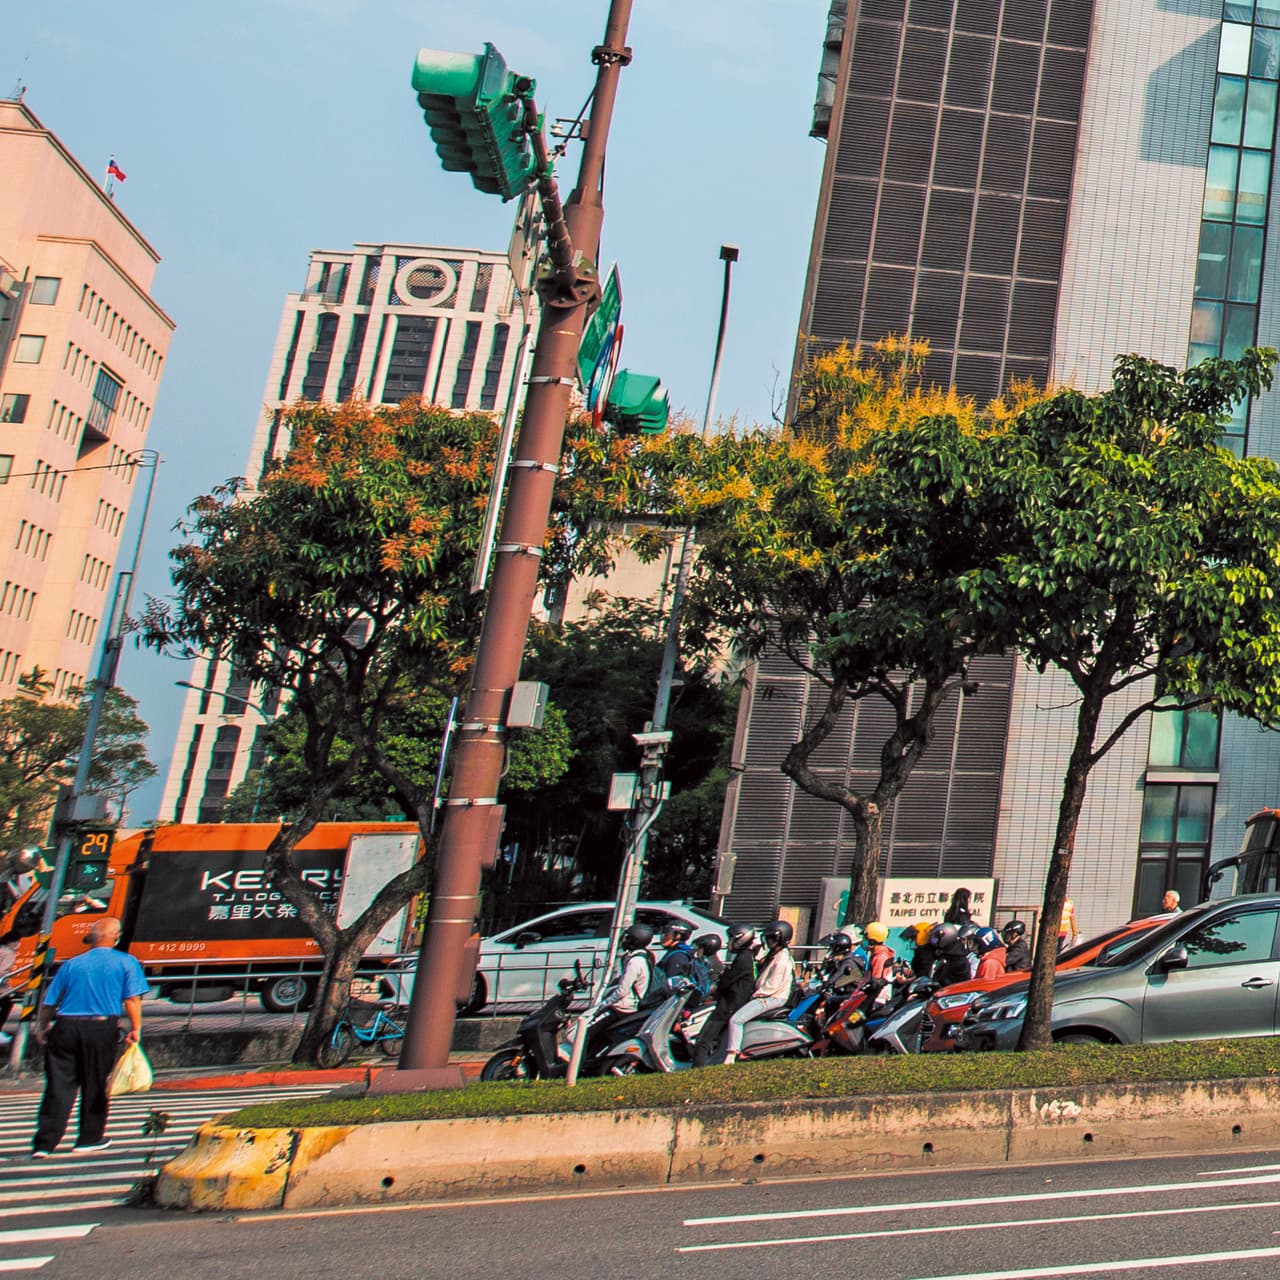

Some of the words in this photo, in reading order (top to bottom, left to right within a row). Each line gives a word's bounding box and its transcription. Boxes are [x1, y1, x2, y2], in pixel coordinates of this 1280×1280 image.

[81, 833, 109, 856] 29
[890, 892, 985, 904] 臺北市立聯院
[890, 908, 916, 917] TAIPEI
[919, 908, 939, 917] CITY
[158, 943, 177, 951] 412
[179, 943, 206, 951] 8999
